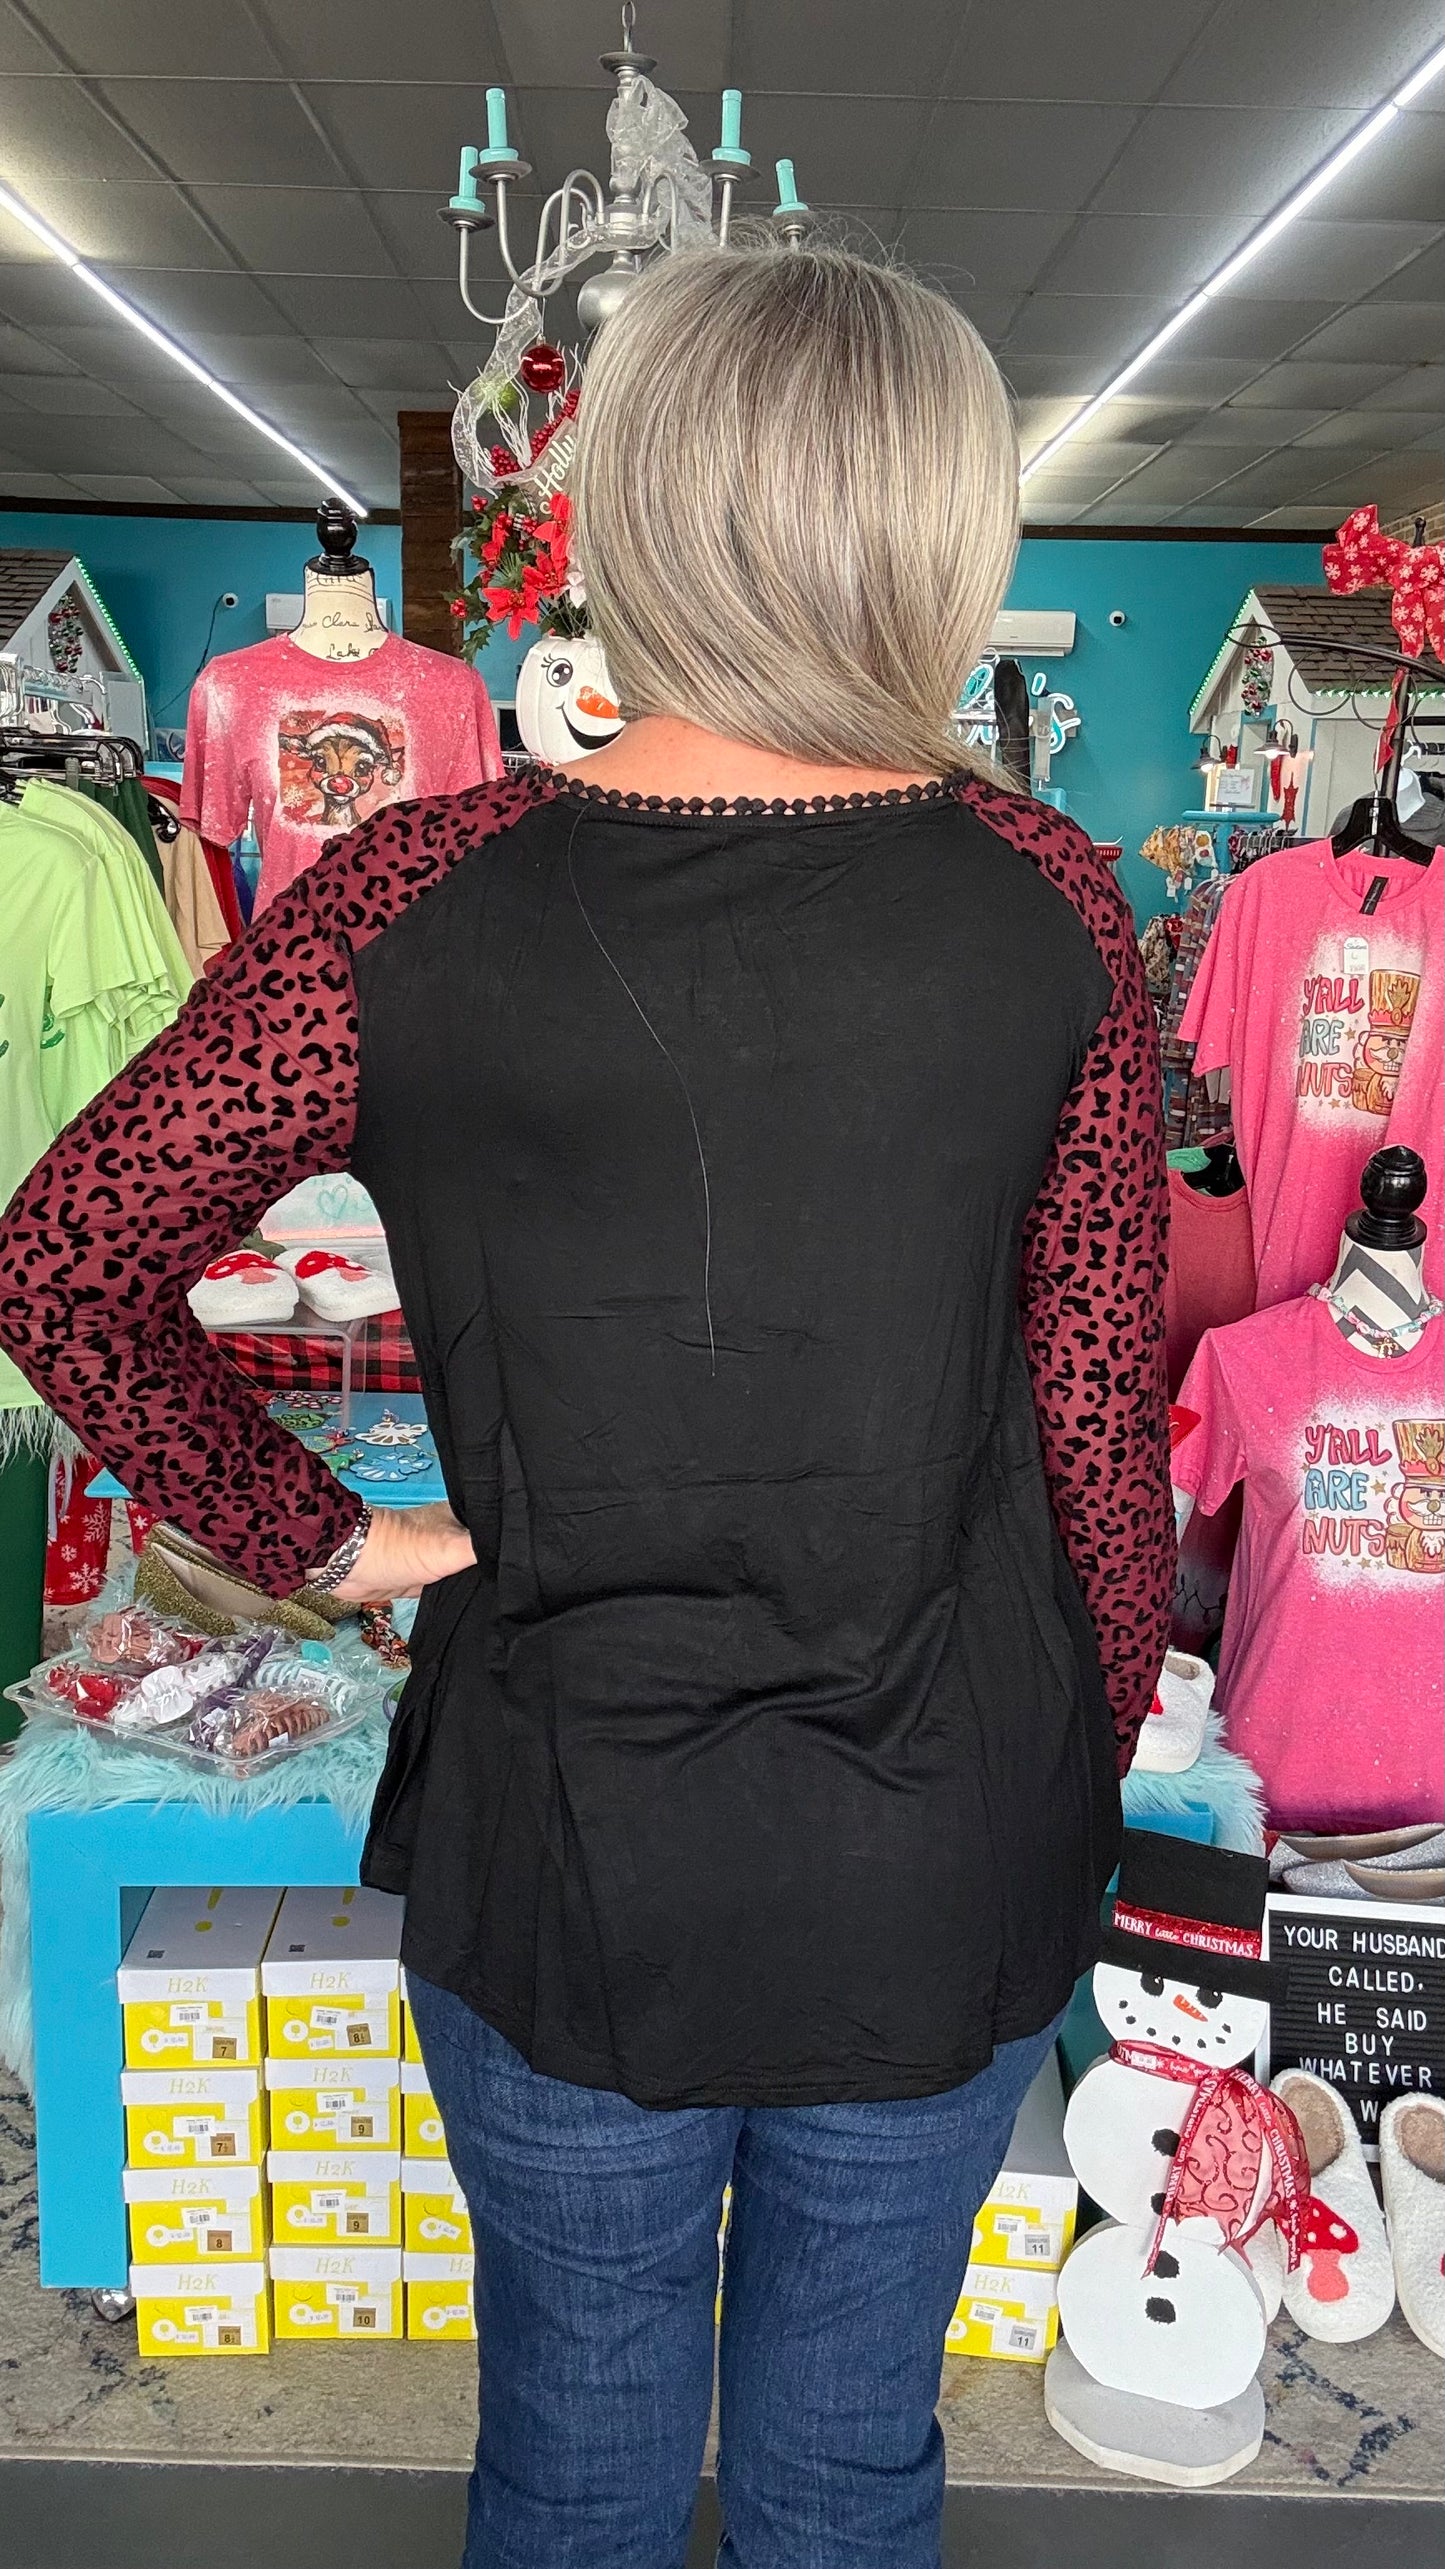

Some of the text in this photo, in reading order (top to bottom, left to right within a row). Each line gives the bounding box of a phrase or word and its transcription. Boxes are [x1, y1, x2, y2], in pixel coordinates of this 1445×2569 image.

[1303, 975, 1365, 1015] Y'ALL
[1300, 1019, 1344, 1057] ARE
[1296, 1062, 1353, 1098] NUTS
[1305, 1423, 1392, 1466] Y'ALL
[1304, 1469, 1369, 1511] ARE
[1303, 1517, 1386, 1557] NUTS
[1113, 1913, 1152, 1935] MERRY
[1182, 1933, 1253, 1957] CHRISTMAS
[1283, 1925, 1338, 1950] YOUR
[168, 1976, 209, 1994] H2K
[310, 1972, 350, 1989] H2K
[1317, 2002, 1427, 2031] HE SAID
[221, 2046, 228, 2057] 7
[1345, 2032, 1394, 2056] BUY
[313, 2067, 353, 2082] H2K
[1299, 2057, 1432, 2088] WHATEVER
[169, 2077, 210, 2094] H2K
[358, 2124, 365, 2135] 9
[315, 2161, 355, 2176] H2K
[1270, 2128, 1296, 2199] CHRISTMAS
[171, 2179, 212, 2195] H2K
[353, 2221, 360, 2230] 9
[216, 2239, 223, 2248] 8
[1032, 2244, 1044, 2254] 11
[315, 2256, 355, 2273] H2K
[177, 2273, 218, 2290] H2K
[974, 2273, 1014, 2294] H2K
[358, 2316, 370, 2325] 10
[1018, 2337, 1029, 2347] 11
